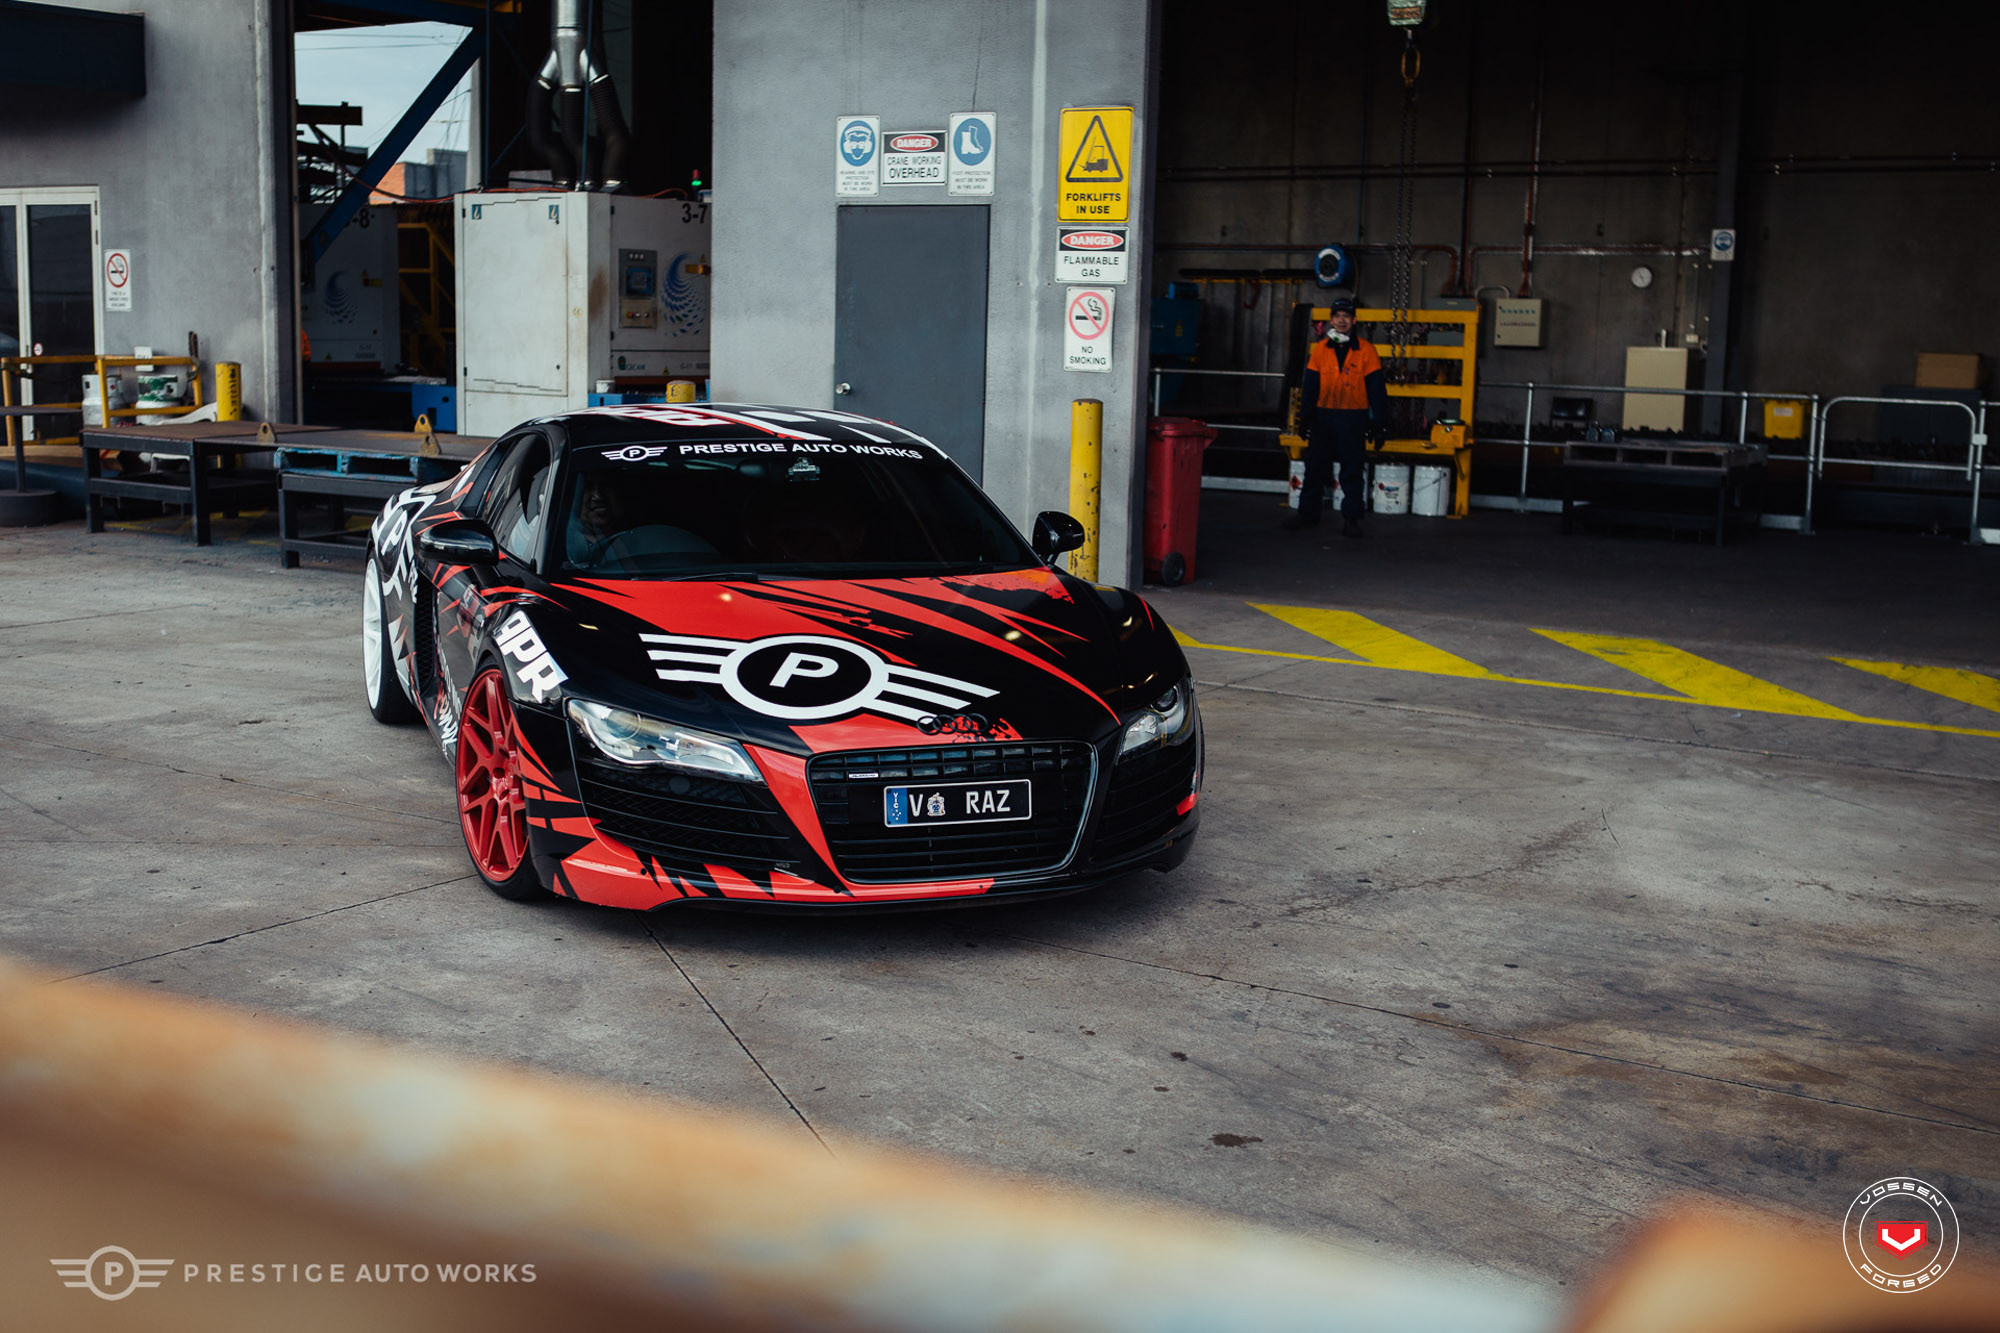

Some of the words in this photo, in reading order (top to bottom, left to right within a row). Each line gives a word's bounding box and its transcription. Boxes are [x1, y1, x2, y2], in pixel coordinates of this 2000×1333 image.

[897, 138, 932, 148] DANGER
[887, 156, 909, 166] CRANE
[889, 167, 940, 179] OVERHEAD
[1066, 193, 1122, 202] FORKLIFTS
[682, 203, 708, 224] 3-7
[1076, 206, 1087, 214] IN
[1090, 205, 1111, 214] USE
[1070, 236, 1115, 246] DANGER
[1064, 255, 1120, 266] FLAMMABLE
[1081, 268, 1101, 278] GAS
[1081, 346, 1094, 355] NO
[1069, 355, 1107, 366] SMOKING
[629, 449, 641, 459] P
[679, 443, 789, 456] PRESTIGE
[791, 443, 848, 455] AUTO
[851, 444, 924, 460] WORKS
[769, 652, 839, 688] P
[909, 794, 924, 817] V
[965, 789, 1011, 814] RAZ
